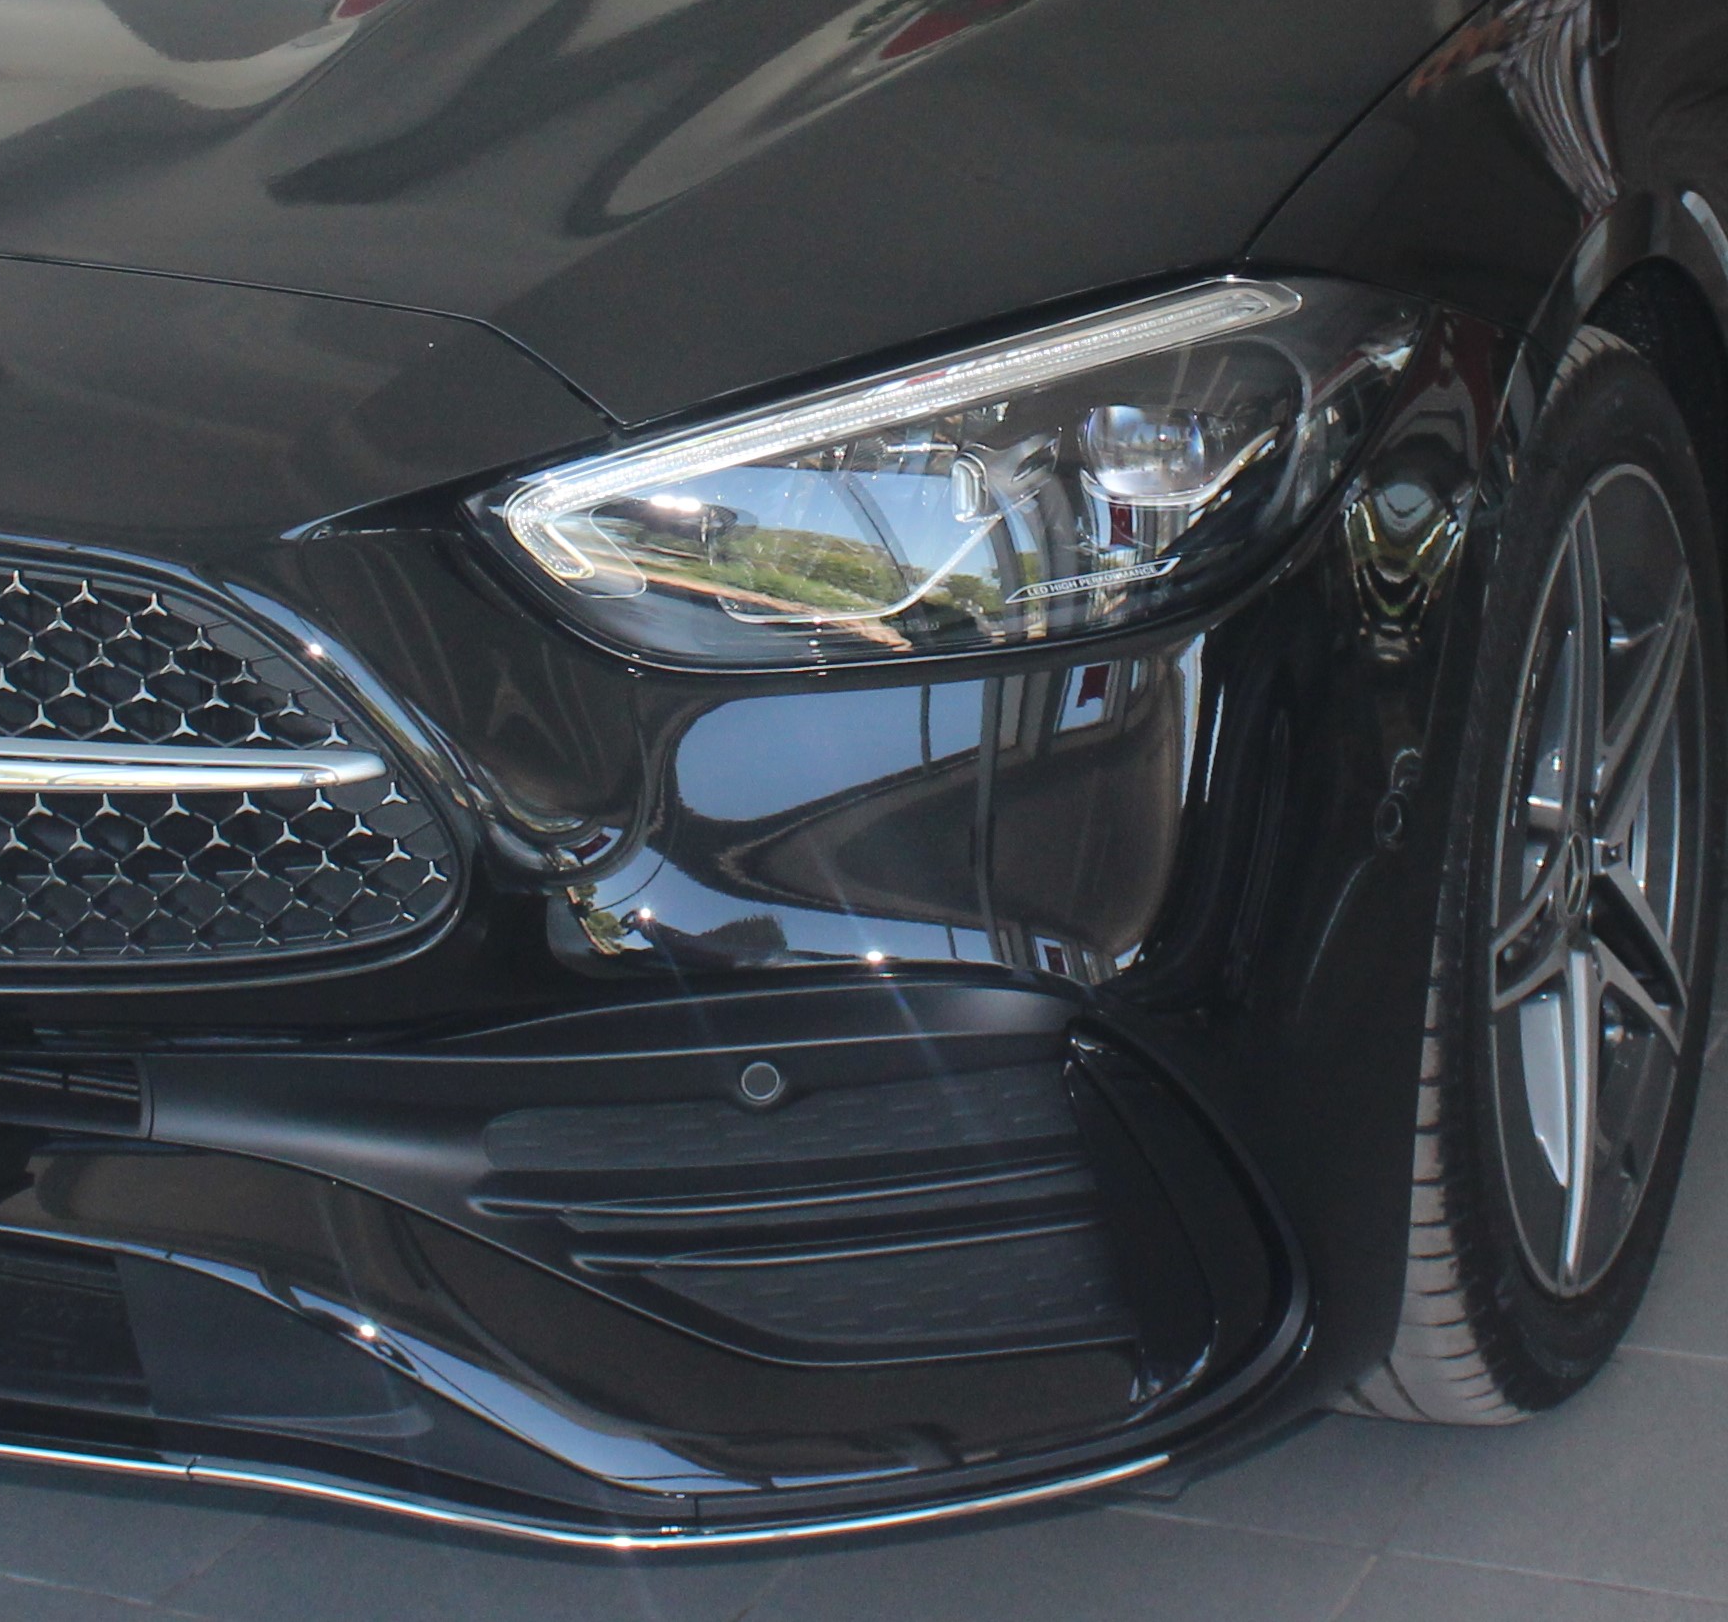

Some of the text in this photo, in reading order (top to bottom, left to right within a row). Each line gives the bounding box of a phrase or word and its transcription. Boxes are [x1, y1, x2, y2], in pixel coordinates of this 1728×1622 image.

[1027, 565, 1156, 597] LED HIGH PERFORMANCE
